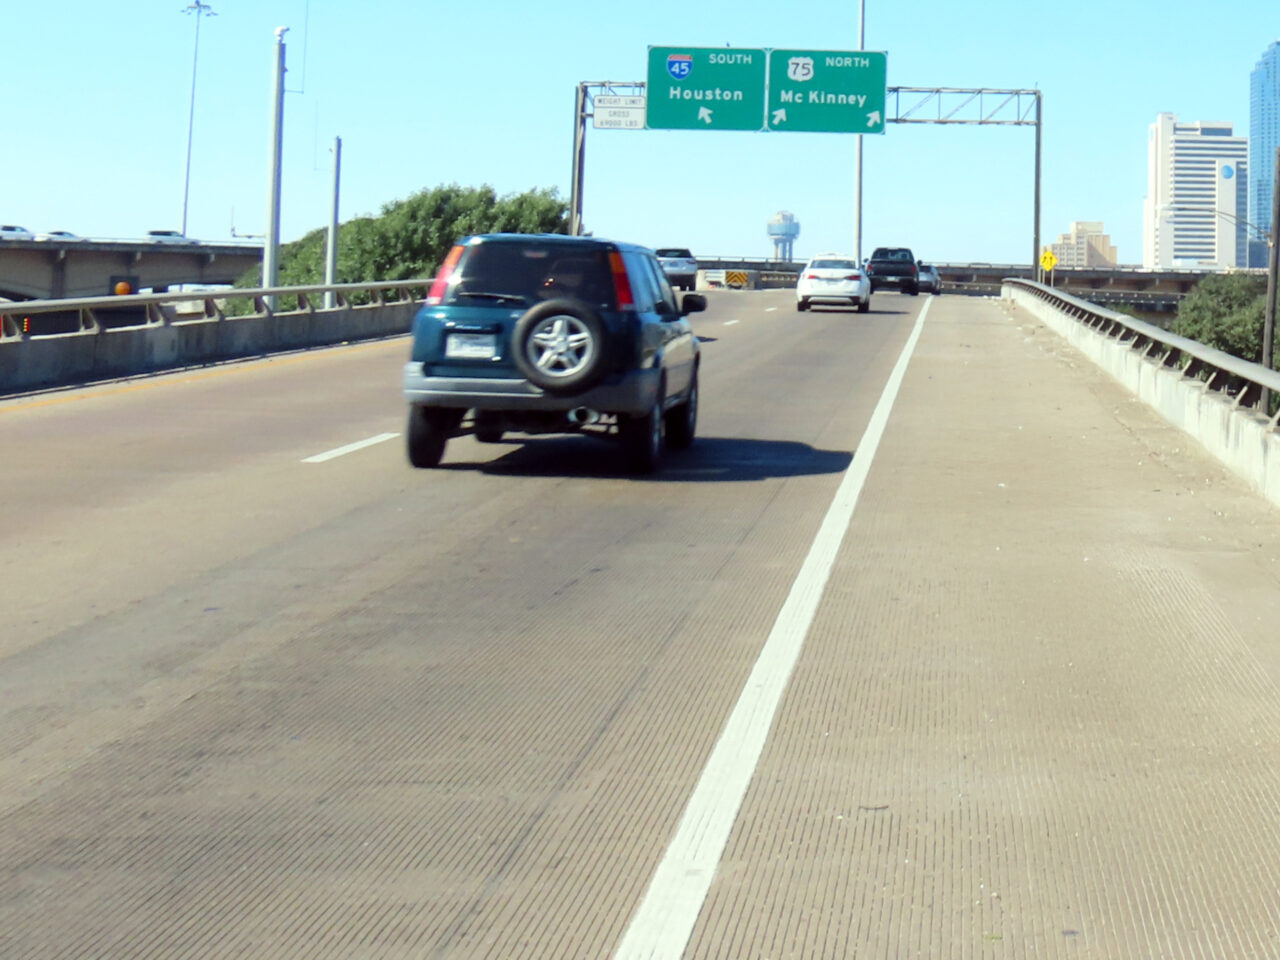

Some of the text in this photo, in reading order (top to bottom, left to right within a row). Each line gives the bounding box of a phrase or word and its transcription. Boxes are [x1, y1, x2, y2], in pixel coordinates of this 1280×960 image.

[709, 53, 752, 65] SOUTH
[825, 56, 869, 68] NORTH
[671, 62, 690, 75] 45
[790, 62, 812, 77] 75
[669, 87, 743, 101] Houston
[808, 90, 867, 108] Kinney
